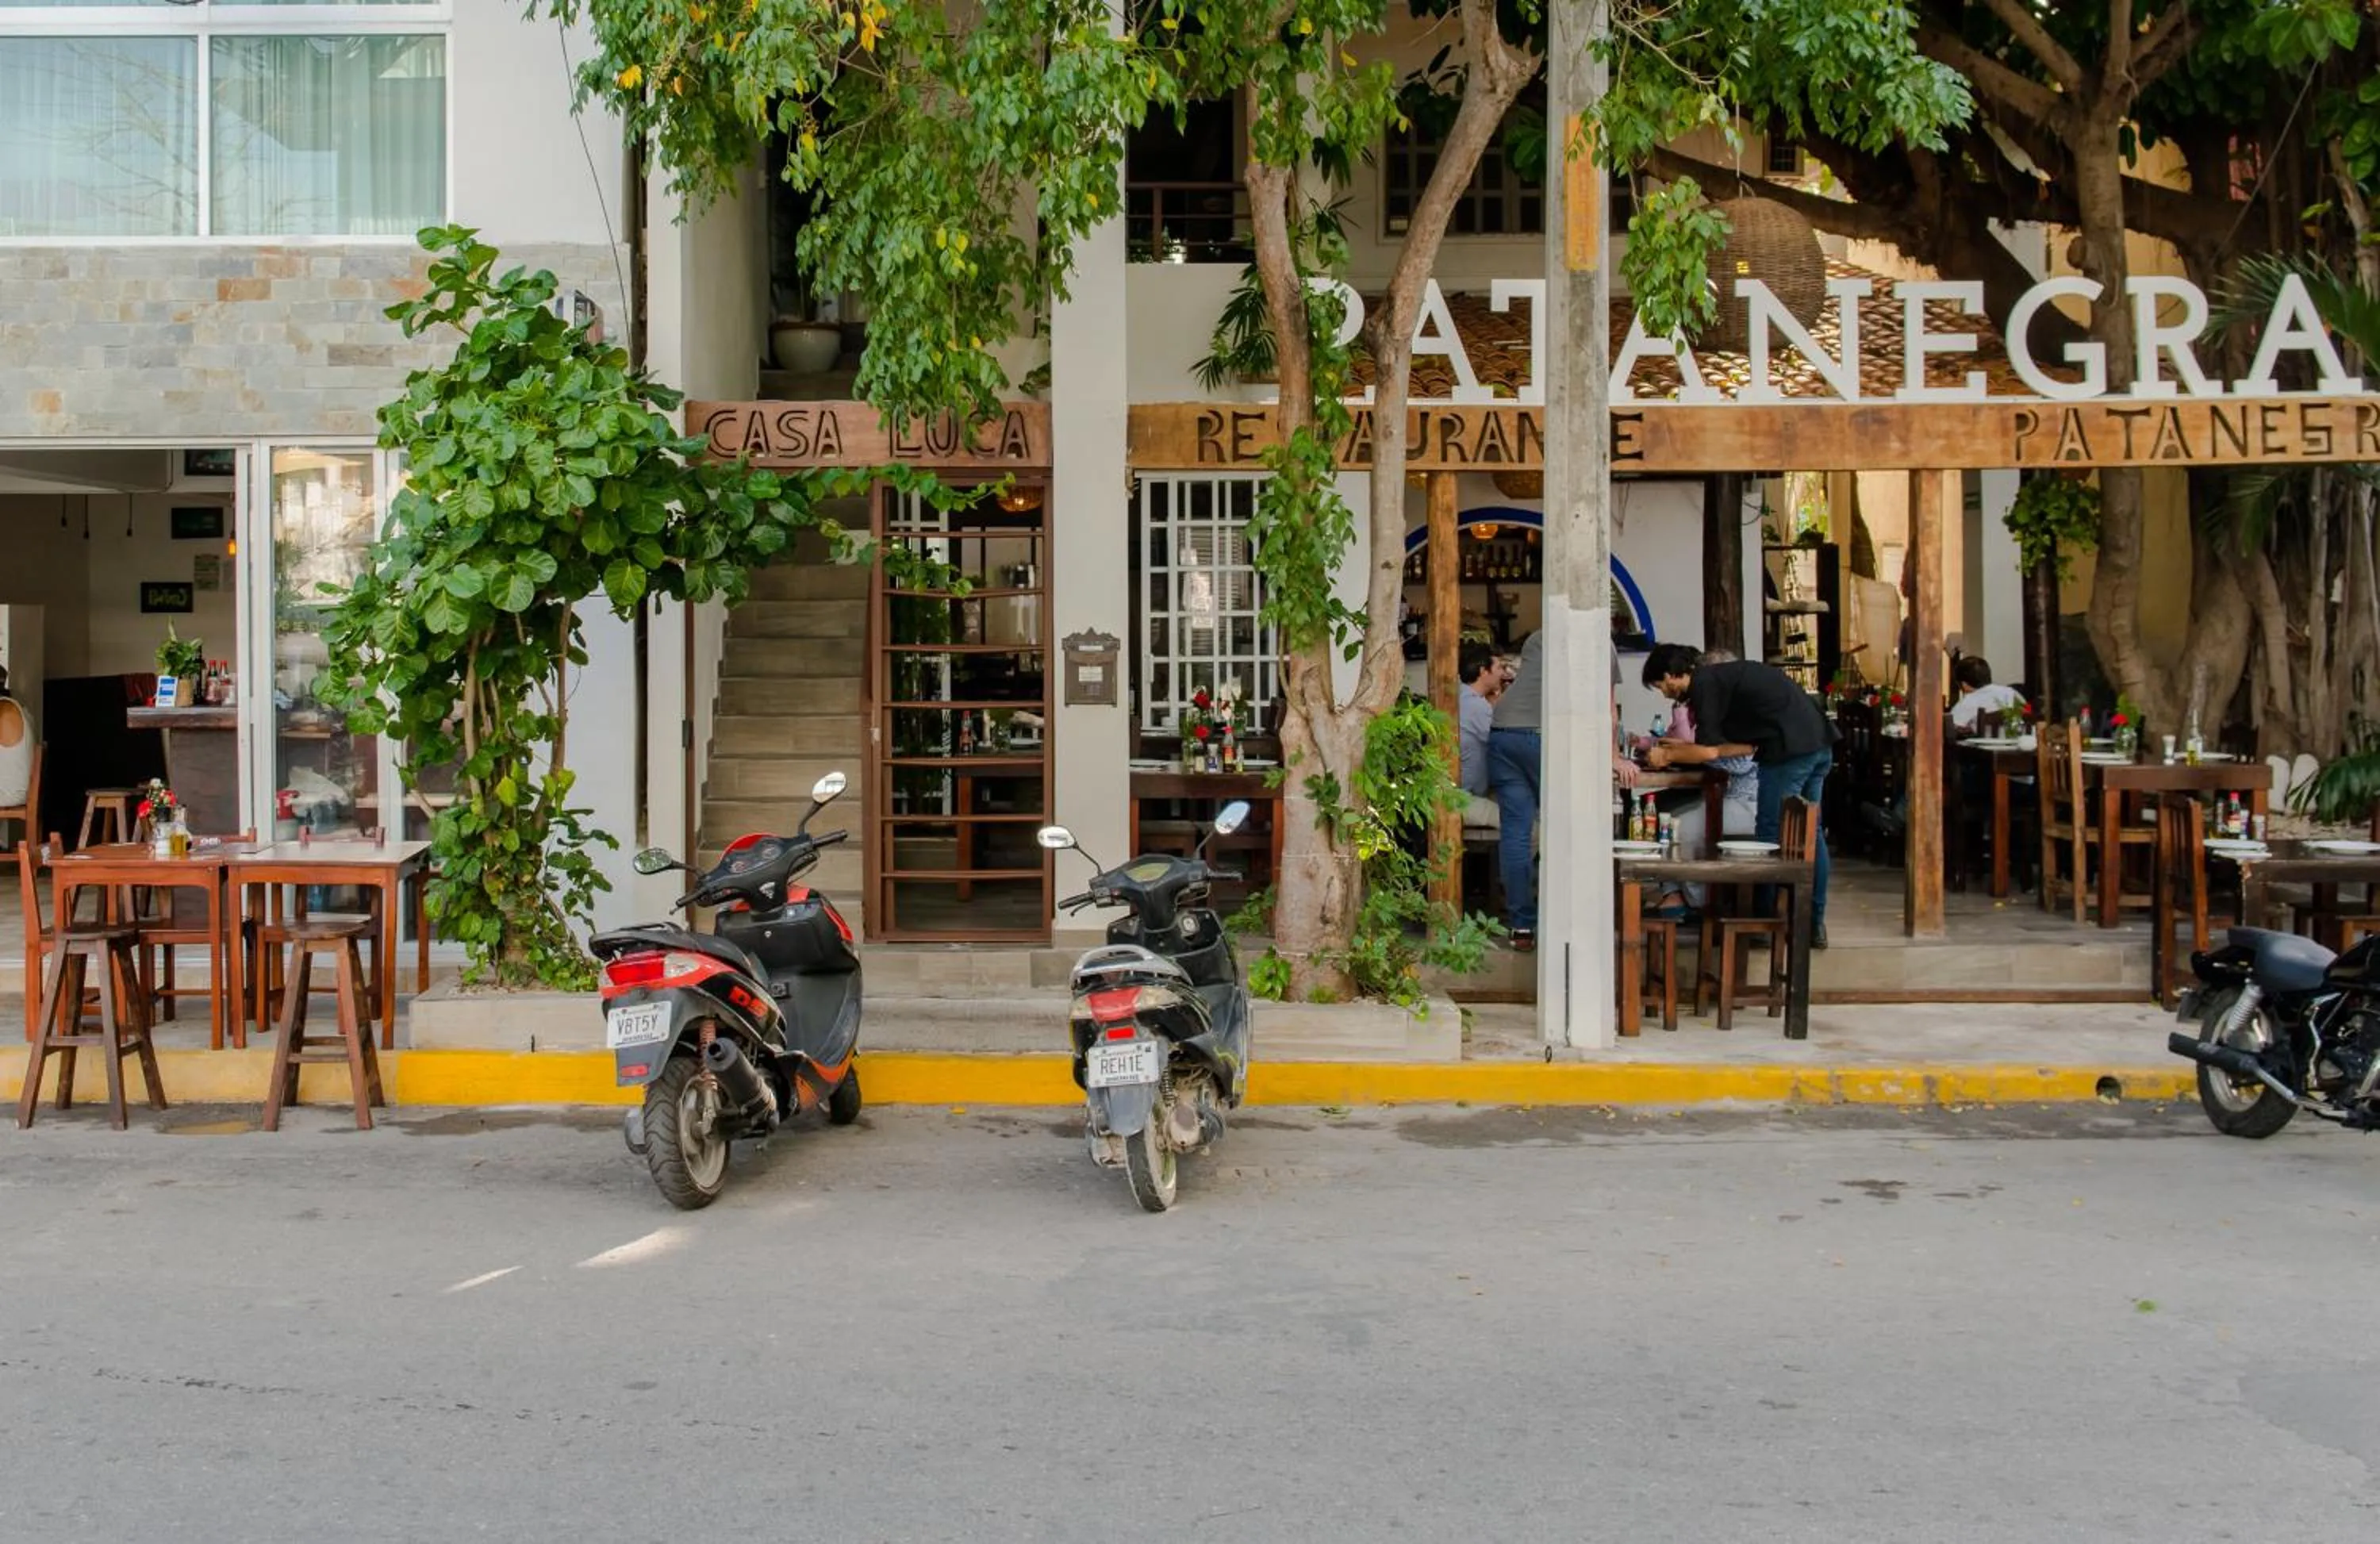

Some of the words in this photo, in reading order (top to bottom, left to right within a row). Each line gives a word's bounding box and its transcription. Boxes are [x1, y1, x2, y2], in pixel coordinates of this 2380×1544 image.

[704, 409, 843, 458] CASA
[889, 407, 1031, 458] LUCA
[1197, 408, 1644, 463] REAURANE
